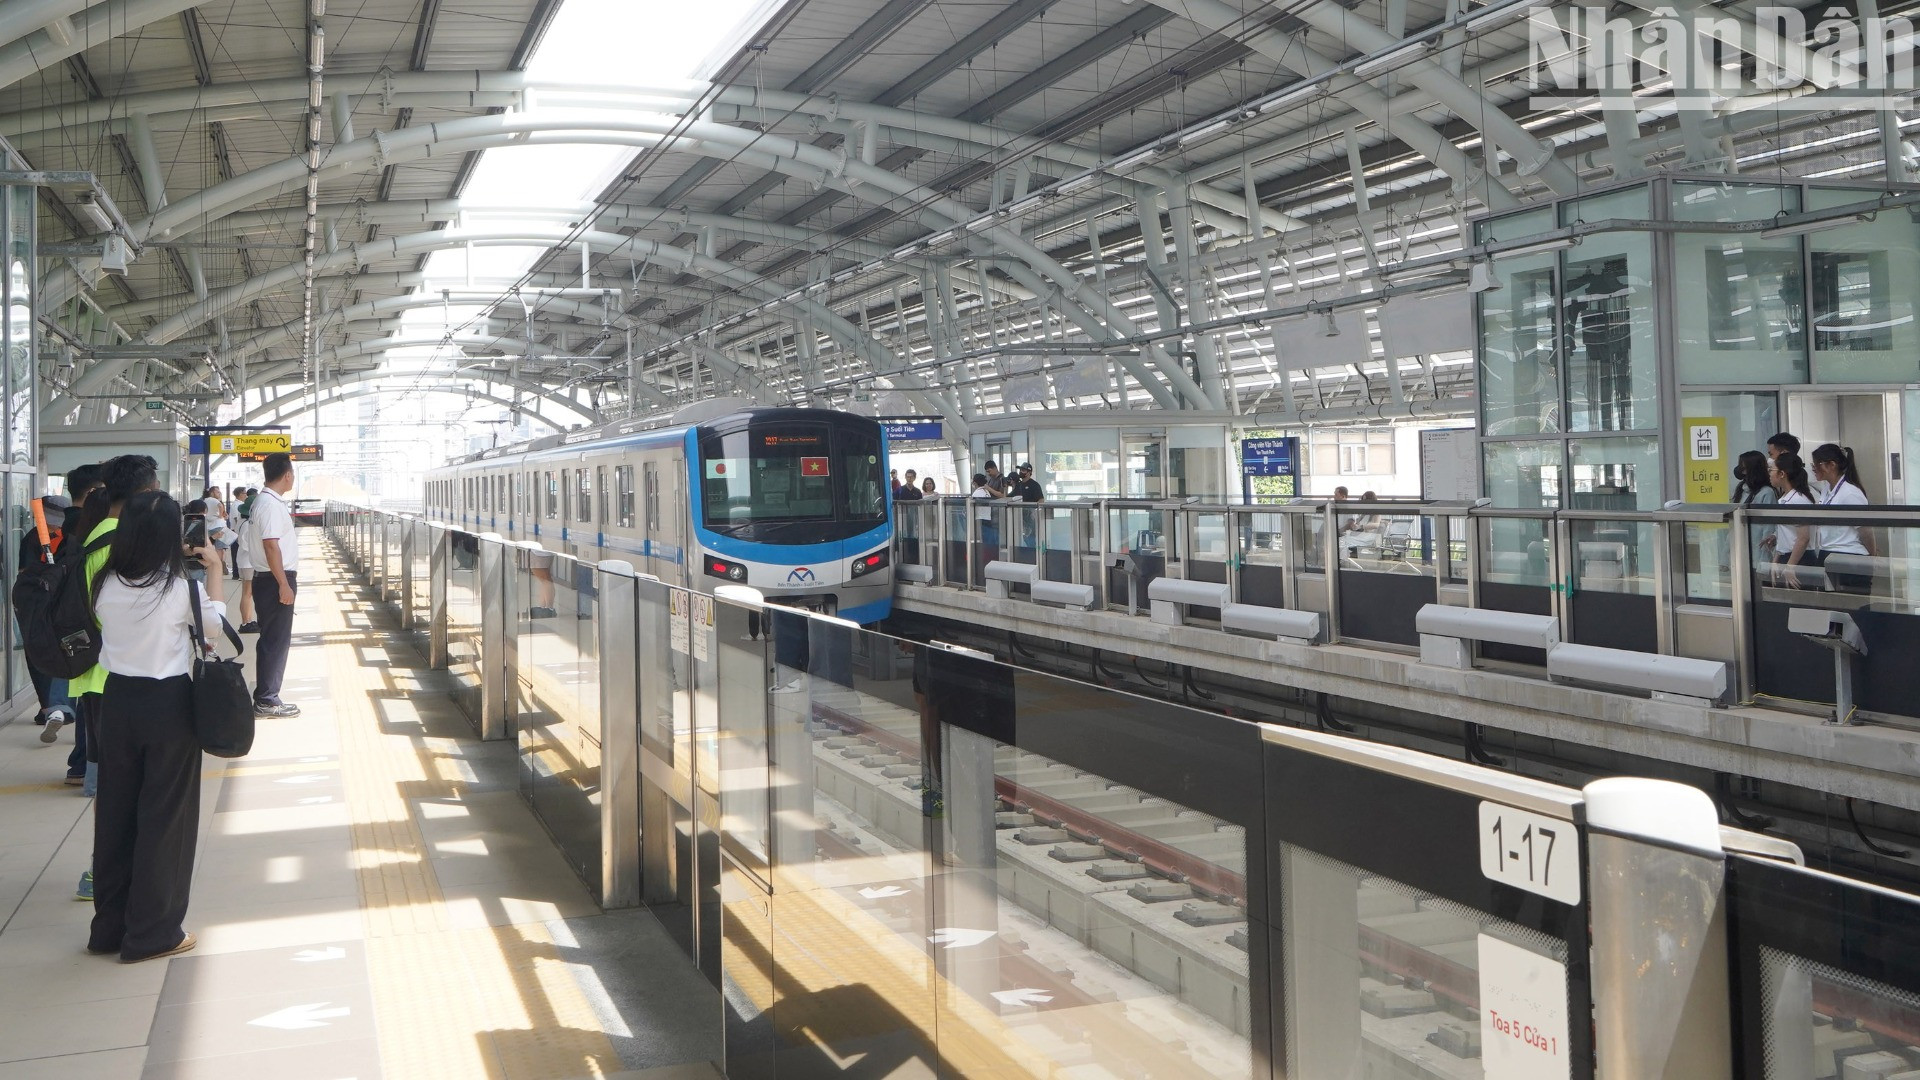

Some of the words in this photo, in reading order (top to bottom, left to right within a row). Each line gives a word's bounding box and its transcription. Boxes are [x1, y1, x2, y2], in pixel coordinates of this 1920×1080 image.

[1692, 469, 1706, 481] Lối
[1709, 472, 1720, 481] ra
[1700, 485, 1713, 494] Exit
[1493, 815, 1556, 886] 1-17
[1490, 1009, 1510, 1035] Toa
[1513, 1019, 1520, 1038] 5
[1523, 1025, 1548, 1052] Cửa
[1551, 1037, 1556, 1055] 1
